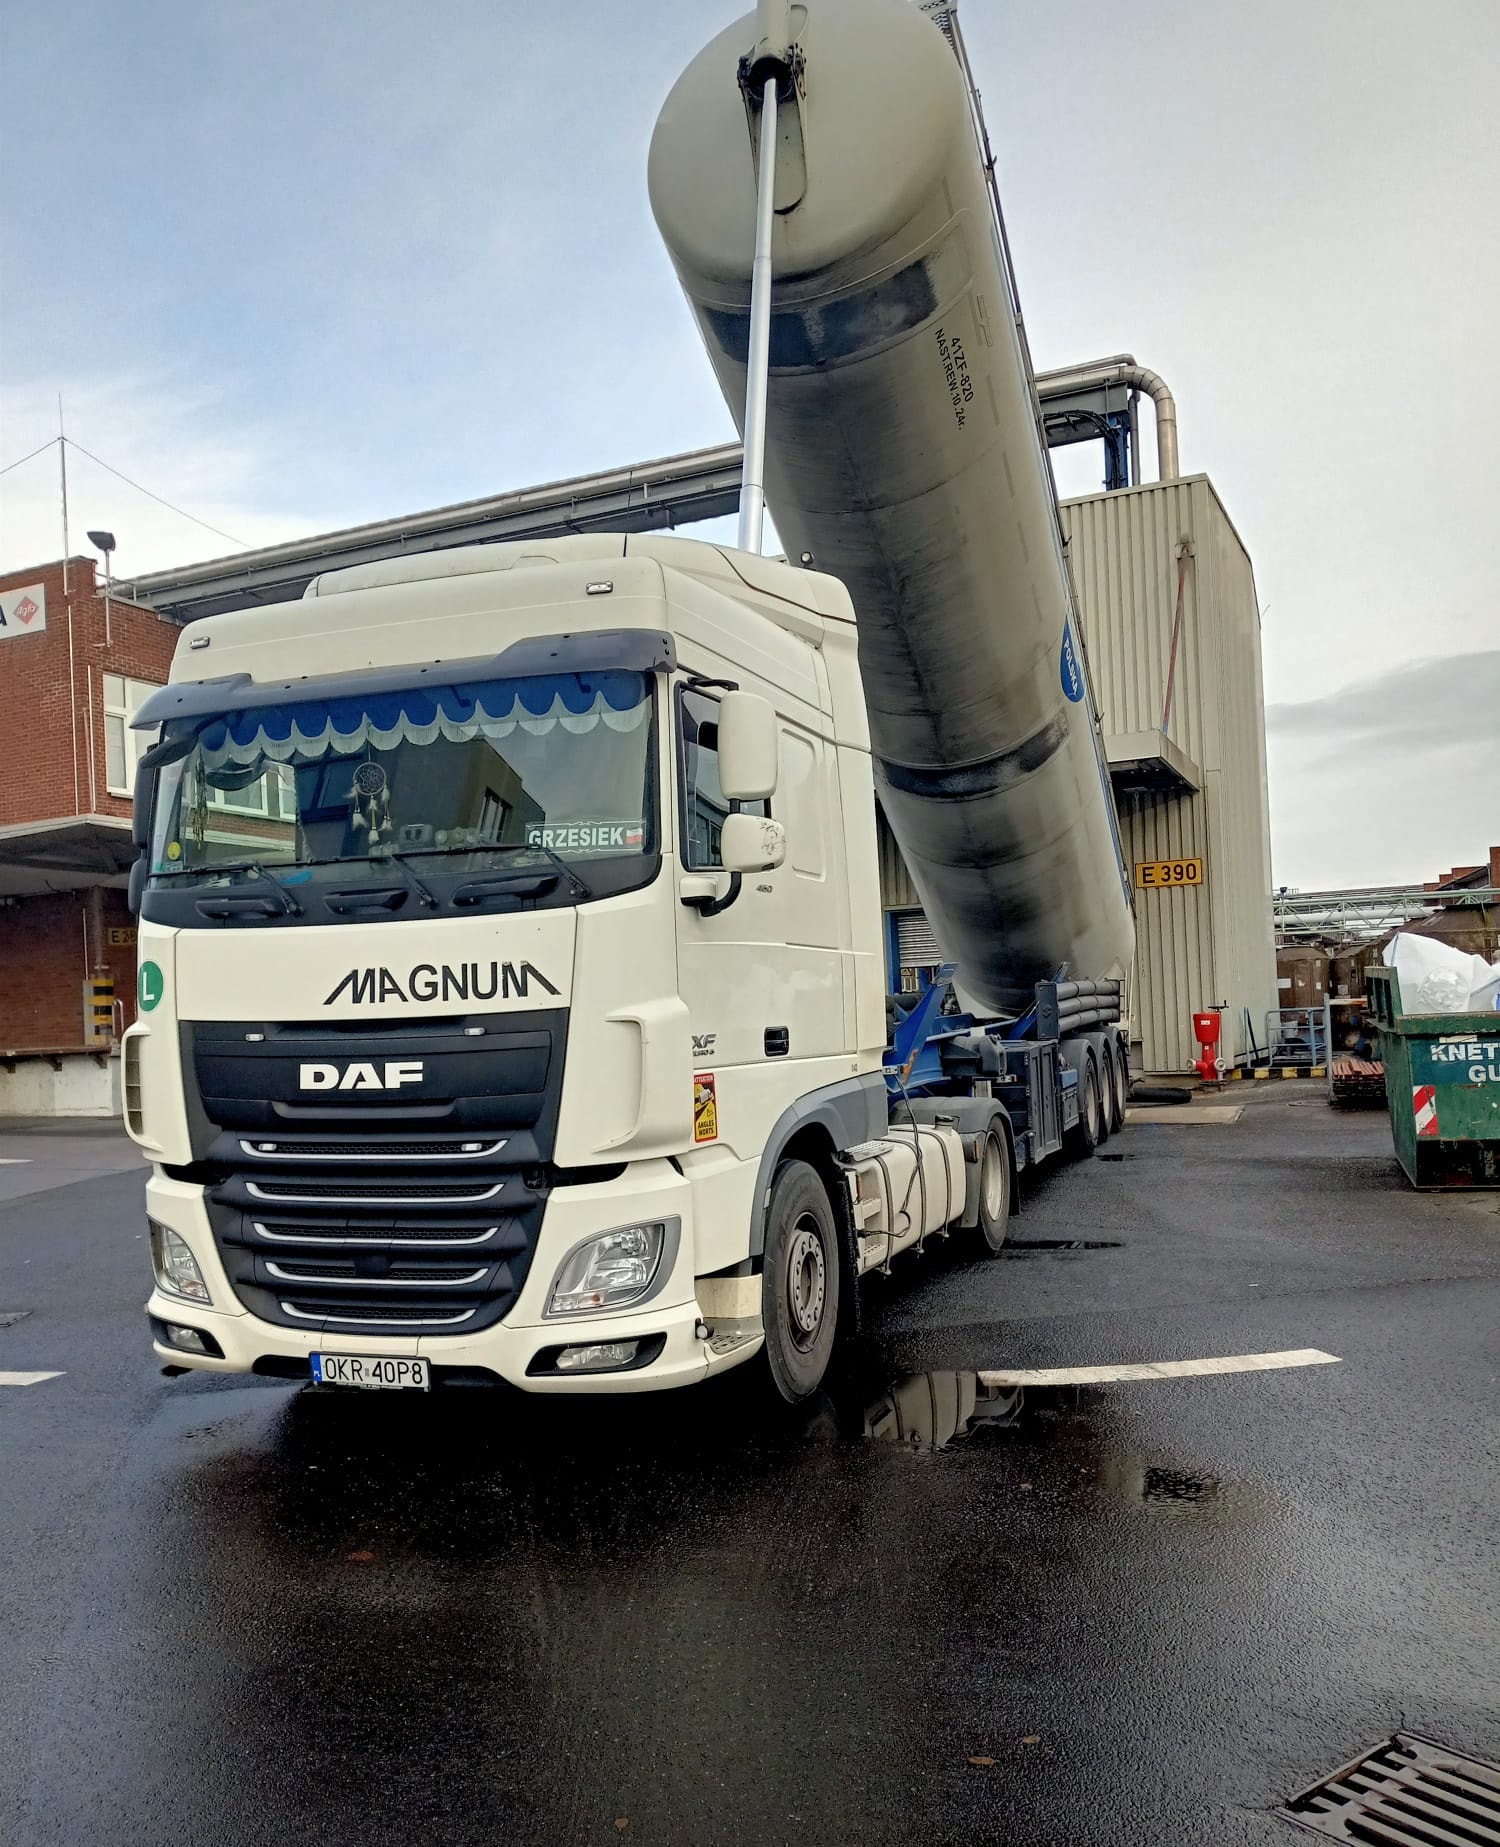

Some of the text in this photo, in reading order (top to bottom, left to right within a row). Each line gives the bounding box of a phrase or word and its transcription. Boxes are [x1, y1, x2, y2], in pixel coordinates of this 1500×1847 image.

[951, 336, 975, 403] 41ZF-820
[528, 826, 624, 849] GRZESIEK
[1142, 863, 1197, 883] E 390
[143, 971, 155, 1001] L
[322, 960, 562, 1006] MAGNUM
[691, 1034, 716, 1049] XF
[1430, 1042, 1500, 1061] KNET
[299, 1061, 424, 1090] DAF
[325, 1357, 363, 1382] OKR
[371, 1360, 423, 1385] 40P8
